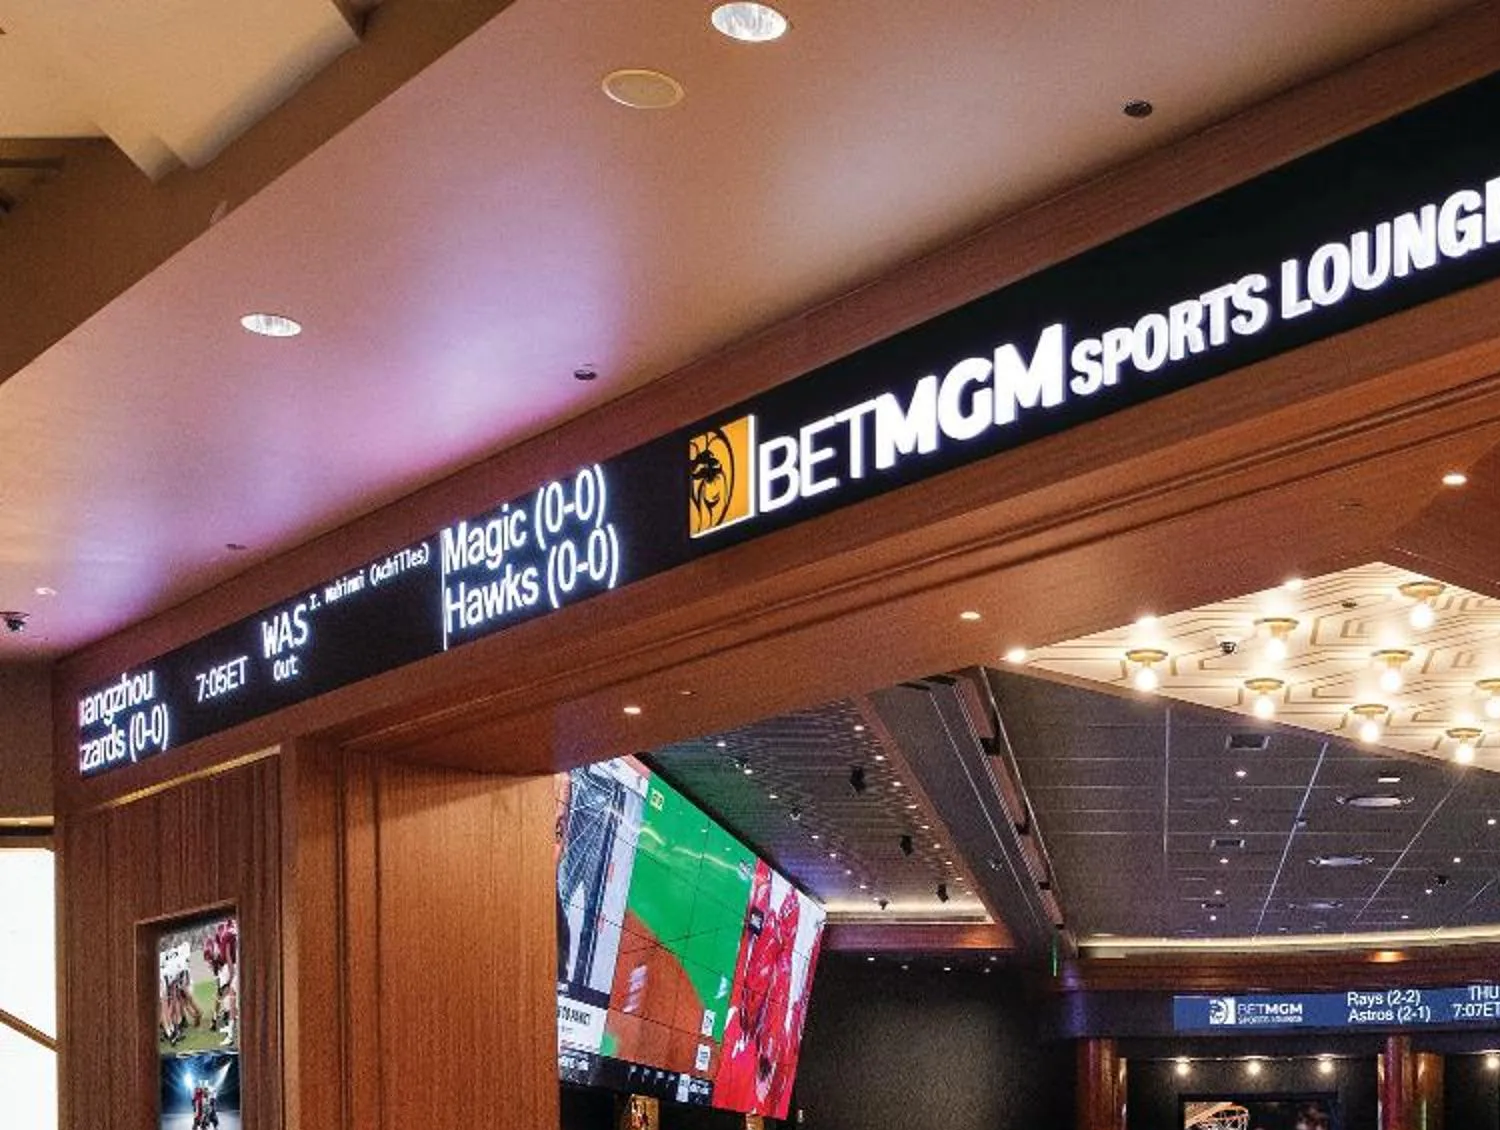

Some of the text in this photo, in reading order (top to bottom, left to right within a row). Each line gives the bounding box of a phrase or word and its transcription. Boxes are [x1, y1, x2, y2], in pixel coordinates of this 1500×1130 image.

[756, 322, 1064, 514] BETMGM
[1071, 273, 1268, 397] SPORTS
[444, 463, 608, 575] Magic (0-0)
[445, 523, 621, 634] Hawks (0-0)
[261, 602, 310, 660] WAS
[195, 656, 249, 702] 7:05ET
[129, 702, 170, 762] (0-0)
[1237, 1003, 1303, 1015] BETMGM
[1346, 989, 1421, 1006] Rays (2-2)
[1348, 1008, 1394, 1023] Astros
[1468, 984, 1500, 1000] THU
